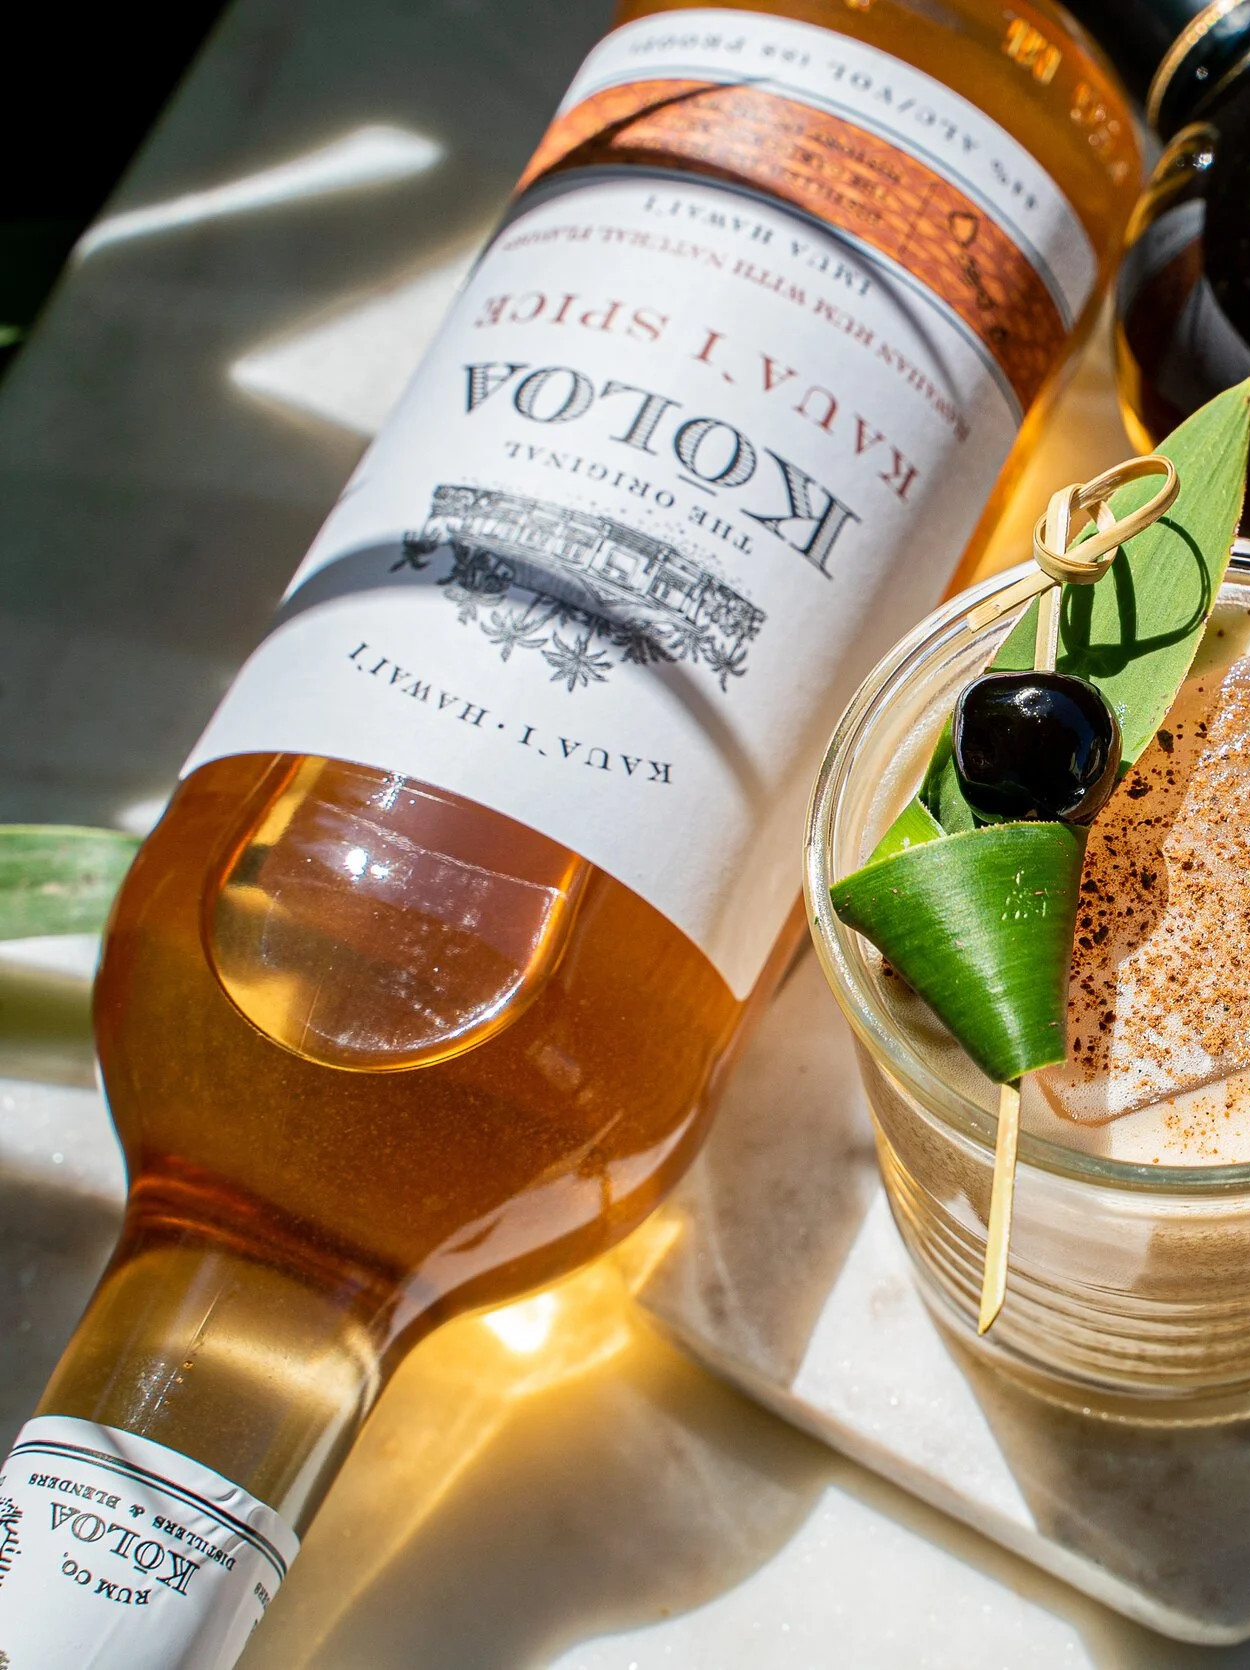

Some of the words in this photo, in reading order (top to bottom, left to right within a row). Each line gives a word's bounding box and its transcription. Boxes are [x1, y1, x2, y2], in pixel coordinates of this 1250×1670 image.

[600, 226, 725, 270] NATURAL
[790, 239, 872, 297] IMUA
[731, 256, 807, 306] WITH
[474, 290, 671, 344] SPICE
[812, 296, 876, 348] RUM
[504, 440, 676, 510] ORIGINAL
[688, 504, 756, 556] THE
[28, 1472, 122, 1510] BLENDERS
[128, 1503, 146, 1518] &
[151, 1515, 237, 1572] DISTILLERS
[94, 1577, 152, 1605] RUM
